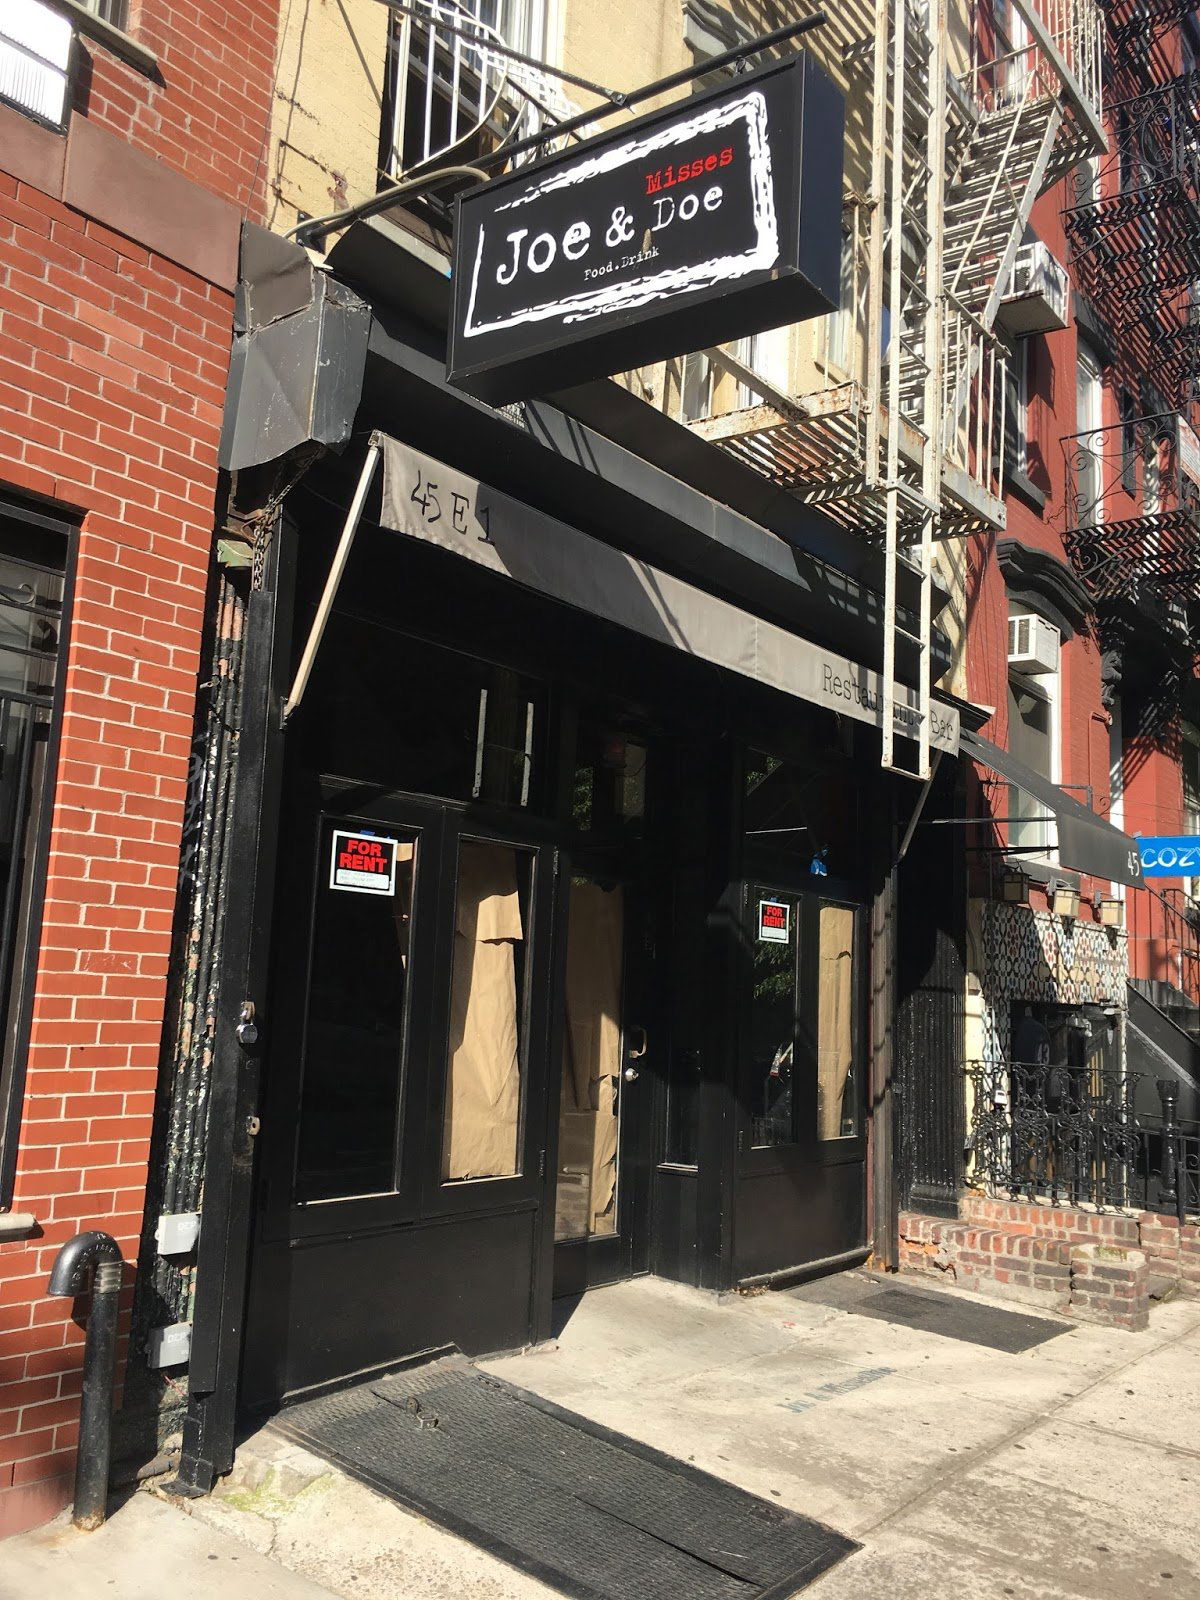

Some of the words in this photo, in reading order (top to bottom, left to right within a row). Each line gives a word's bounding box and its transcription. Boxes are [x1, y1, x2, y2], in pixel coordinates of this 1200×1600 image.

[645, 146, 733, 195] Misses
[495, 220, 592, 285] Joe
[605, 206, 635, 247] &
[651, 185, 723, 232] Doe
[410, 469, 442, 523] 45
[450, 491, 470, 535] E
[477, 506, 496, 547] 1
[929, 709, 953, 742] Bar
[346, 839, 383, 857] FOR
[339, 852, 388, 873] RENT
[1127, 850, 1140, 877] 45
[763, 915, 786, 928] RENT
[766, 906, 783, 917] FOR
